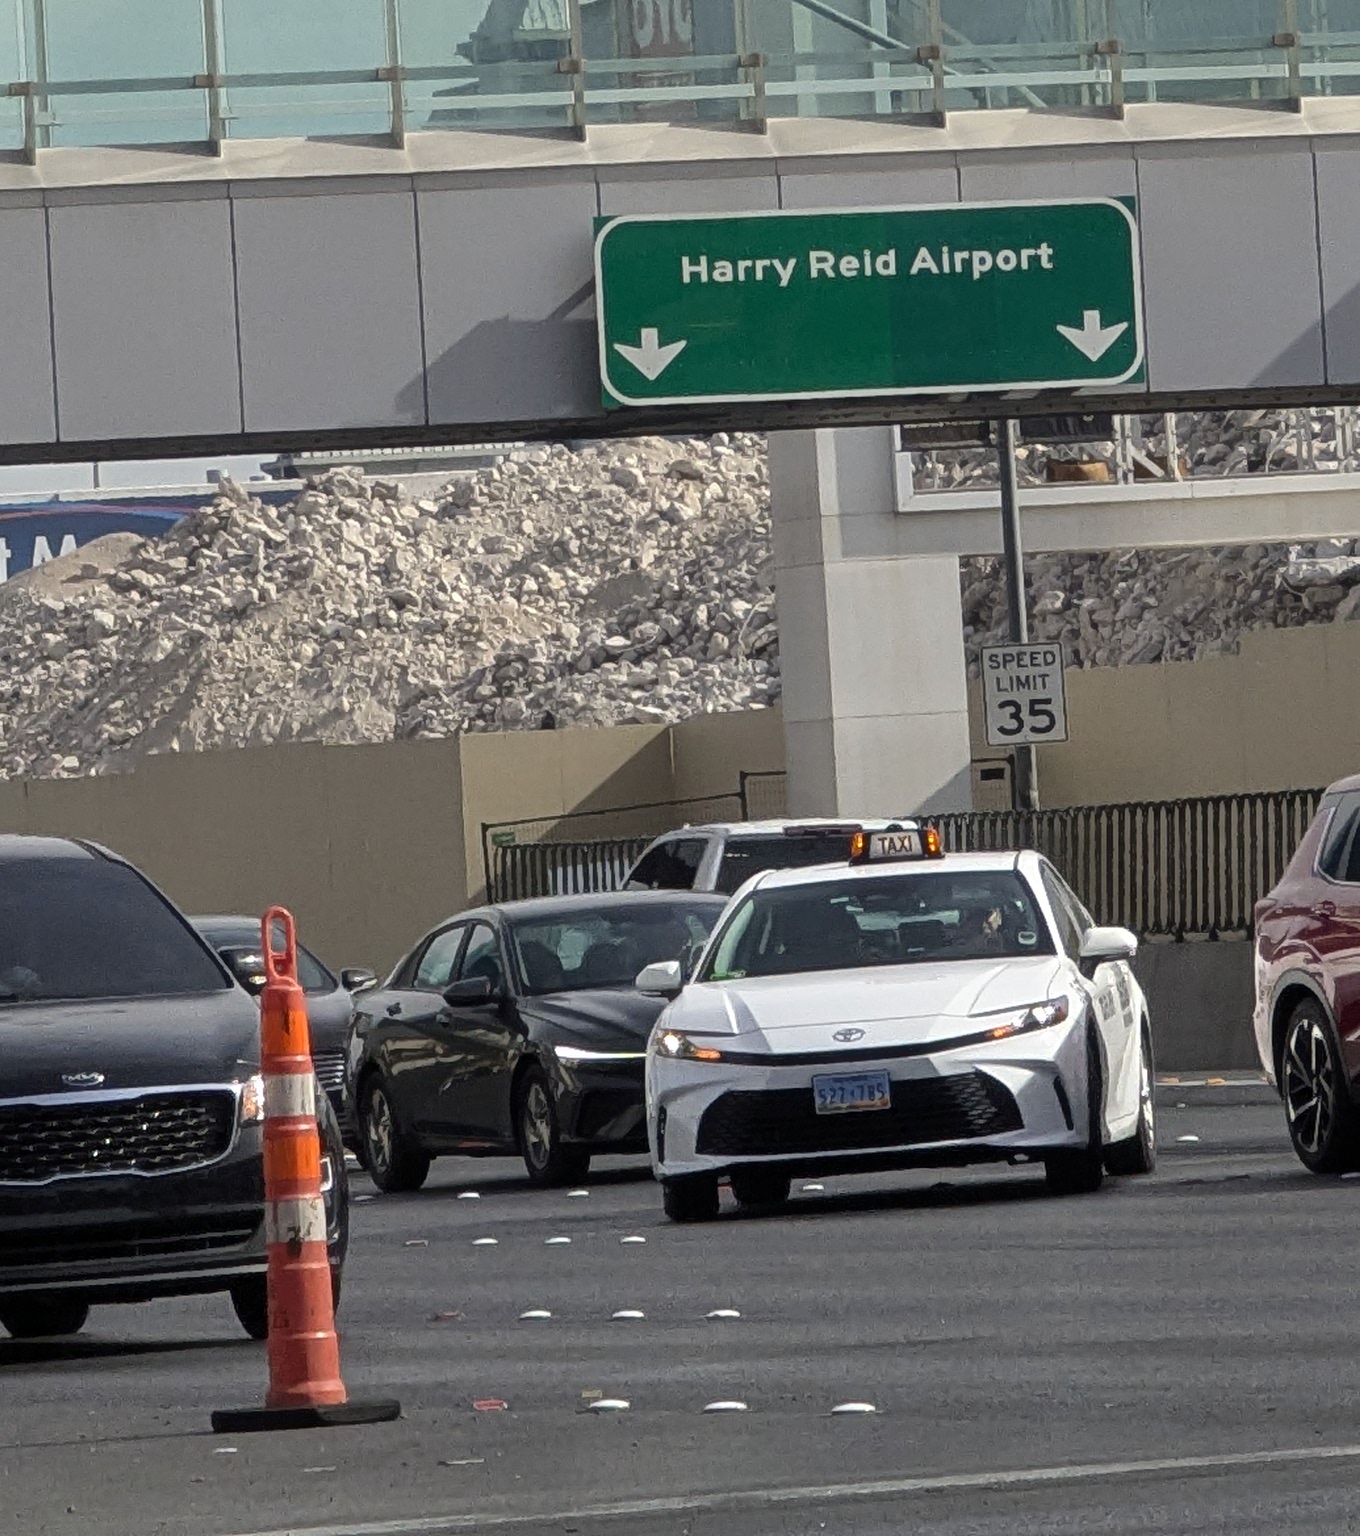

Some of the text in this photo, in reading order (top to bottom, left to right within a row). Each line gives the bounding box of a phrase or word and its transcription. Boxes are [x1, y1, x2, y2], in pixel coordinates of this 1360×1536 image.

[681, 241, 1054, 287] Harry Reid Airport
[988, 650, 1056, 670] SPEED
[995, 673, 1050, 693] LIMIT
[996, 697, 1057, 736] 35
[877, 835, 912, 855] TAXI
